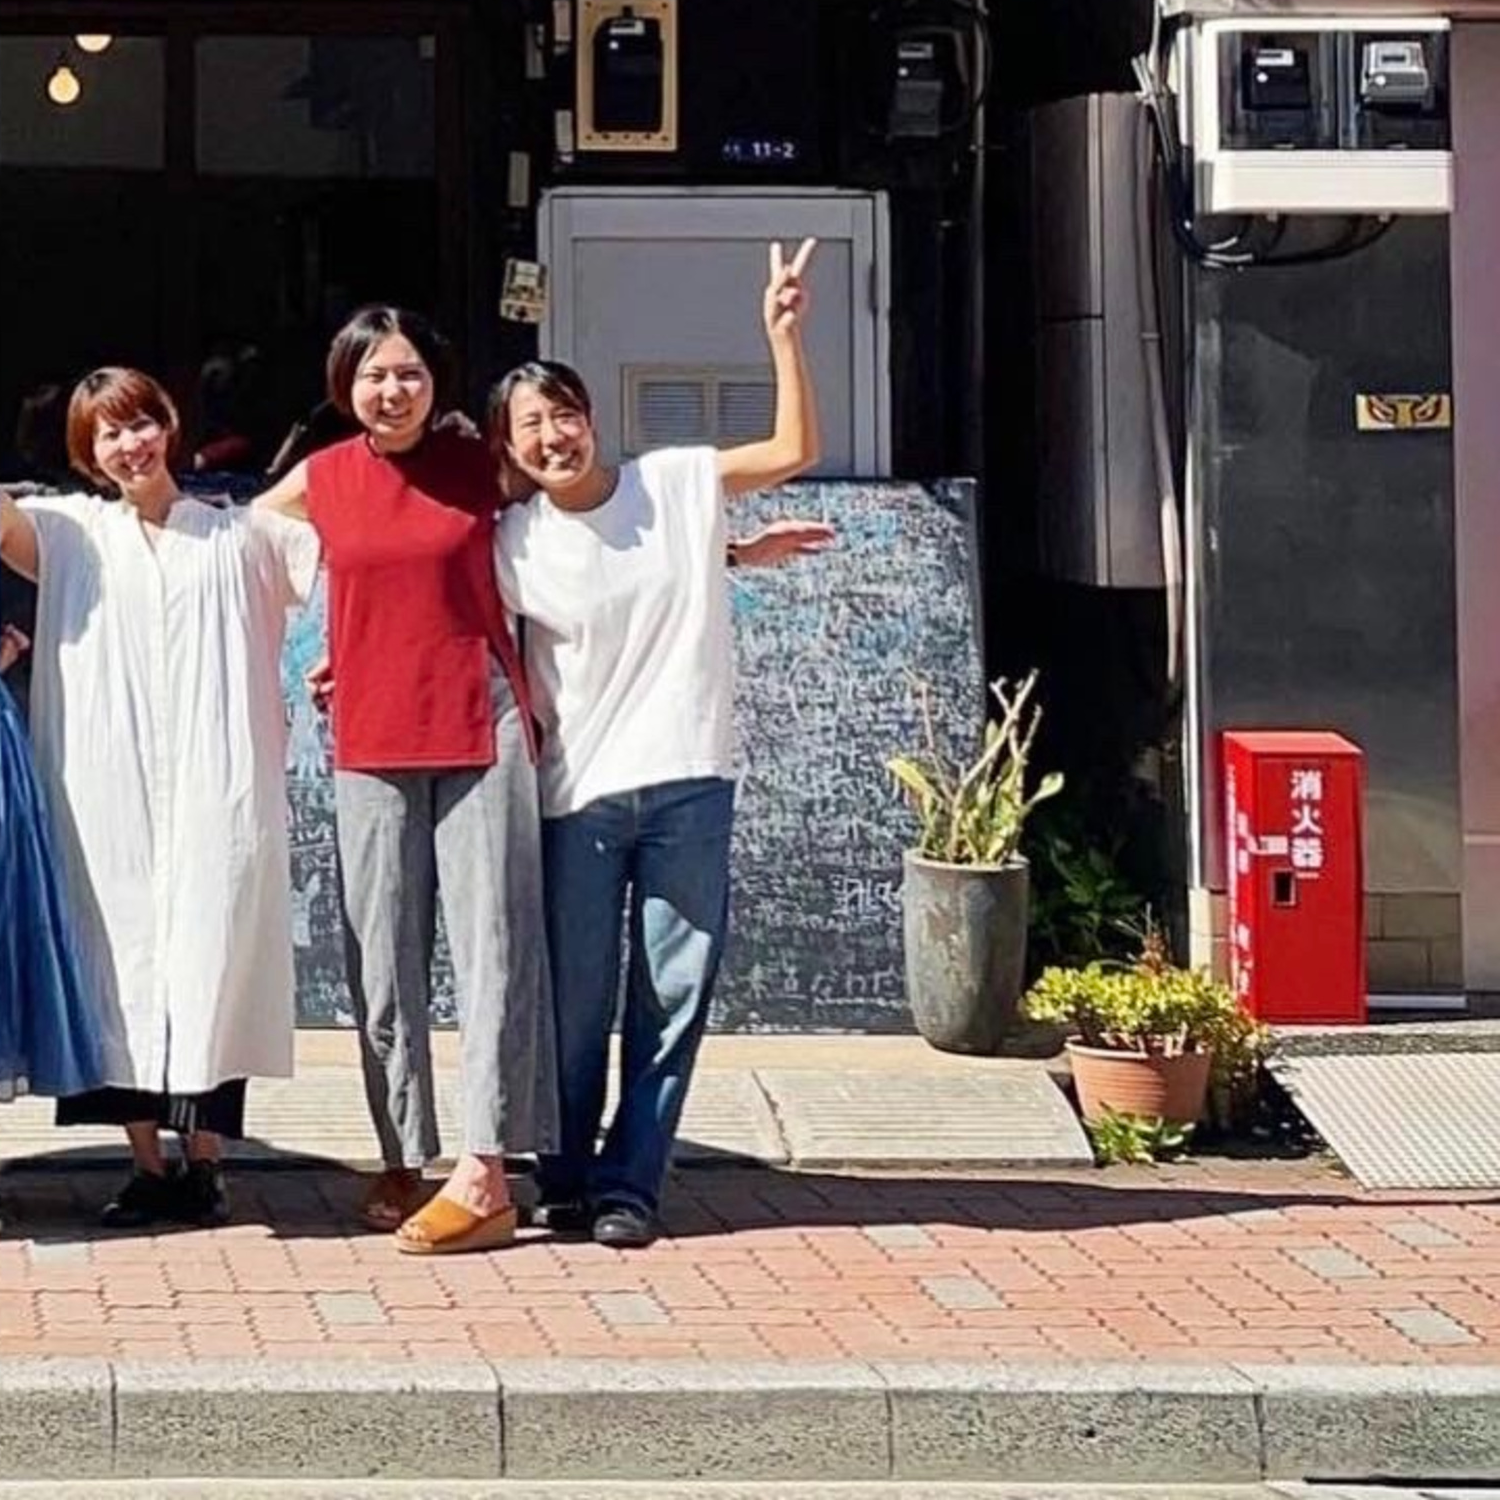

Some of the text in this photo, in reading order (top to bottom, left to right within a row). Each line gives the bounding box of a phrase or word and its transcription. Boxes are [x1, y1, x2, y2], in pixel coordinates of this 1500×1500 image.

[752, 142, 795, 158] 11-2
[1291, 770, 1323, 869] 消火器
